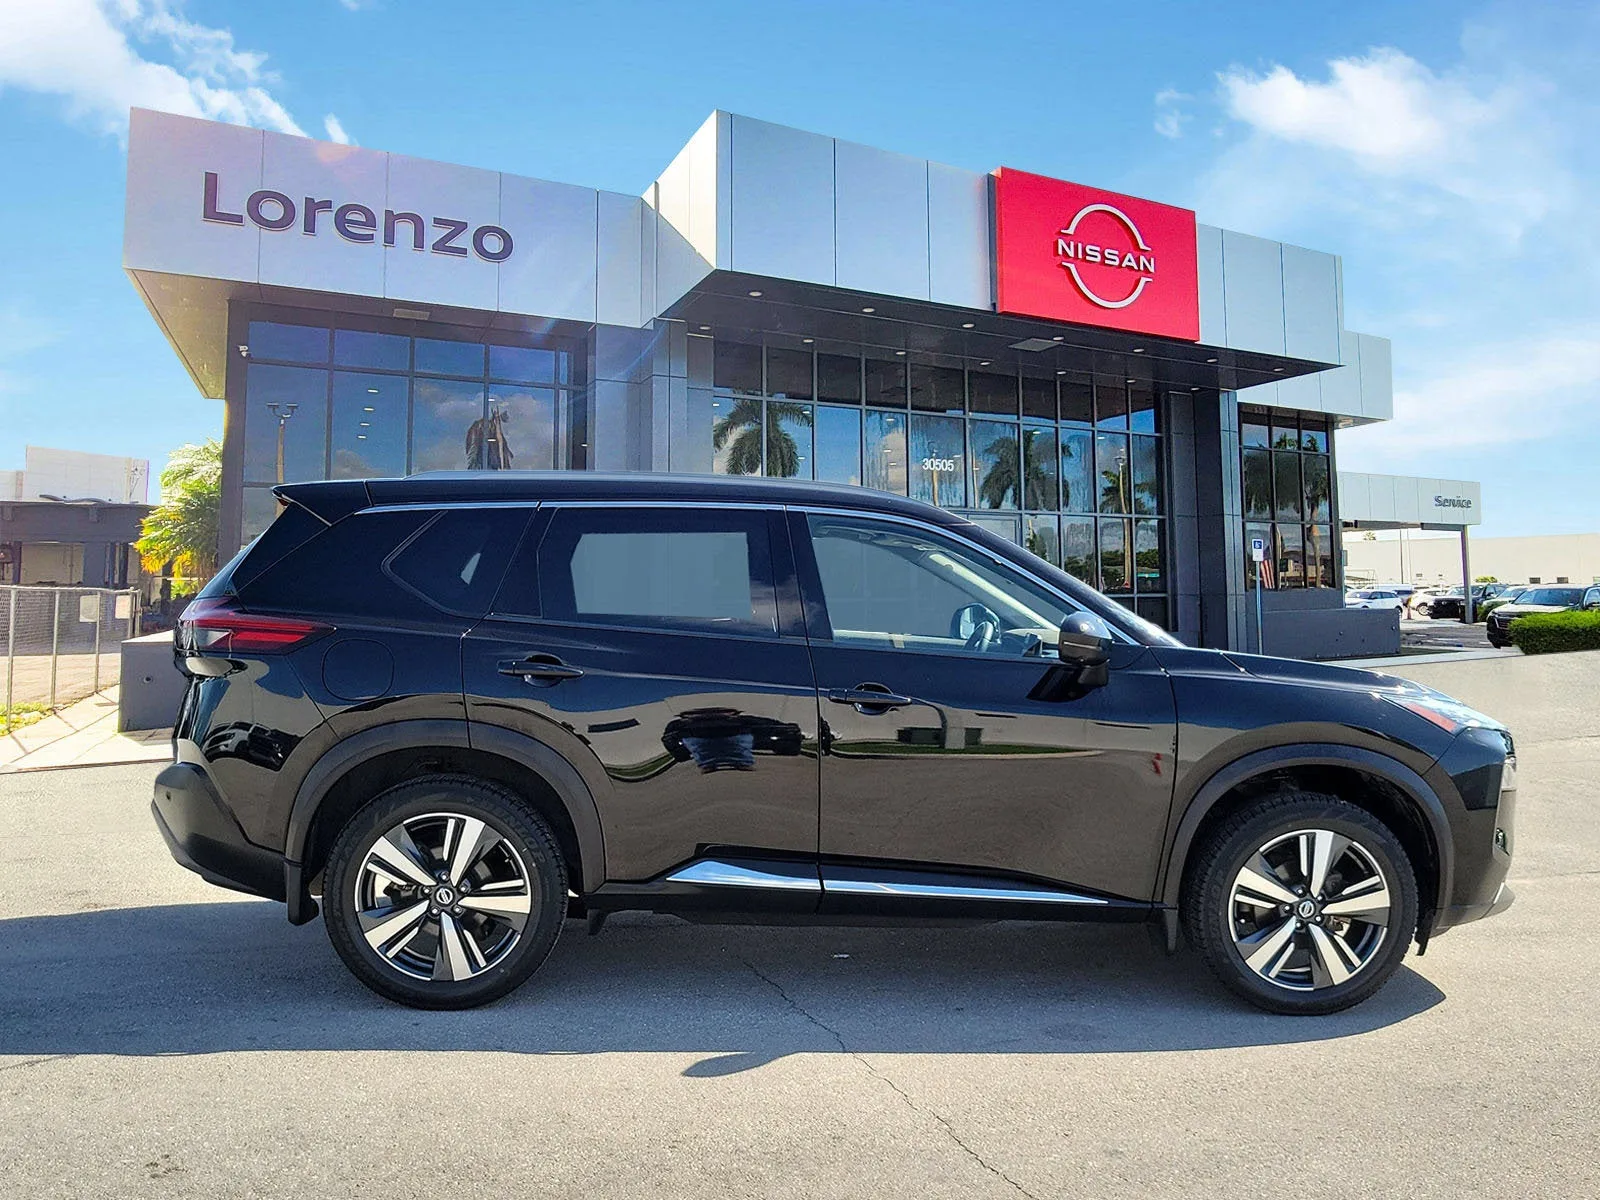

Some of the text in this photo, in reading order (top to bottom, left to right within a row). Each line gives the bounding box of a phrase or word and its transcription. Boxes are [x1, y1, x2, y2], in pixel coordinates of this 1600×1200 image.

[203, 171, 514, 263] Lorenzo
[1057, 238, 1155, 273] NISSAN
[922, 458, 955, 471] 30505
[1434, 495, 1472, 509] Service
